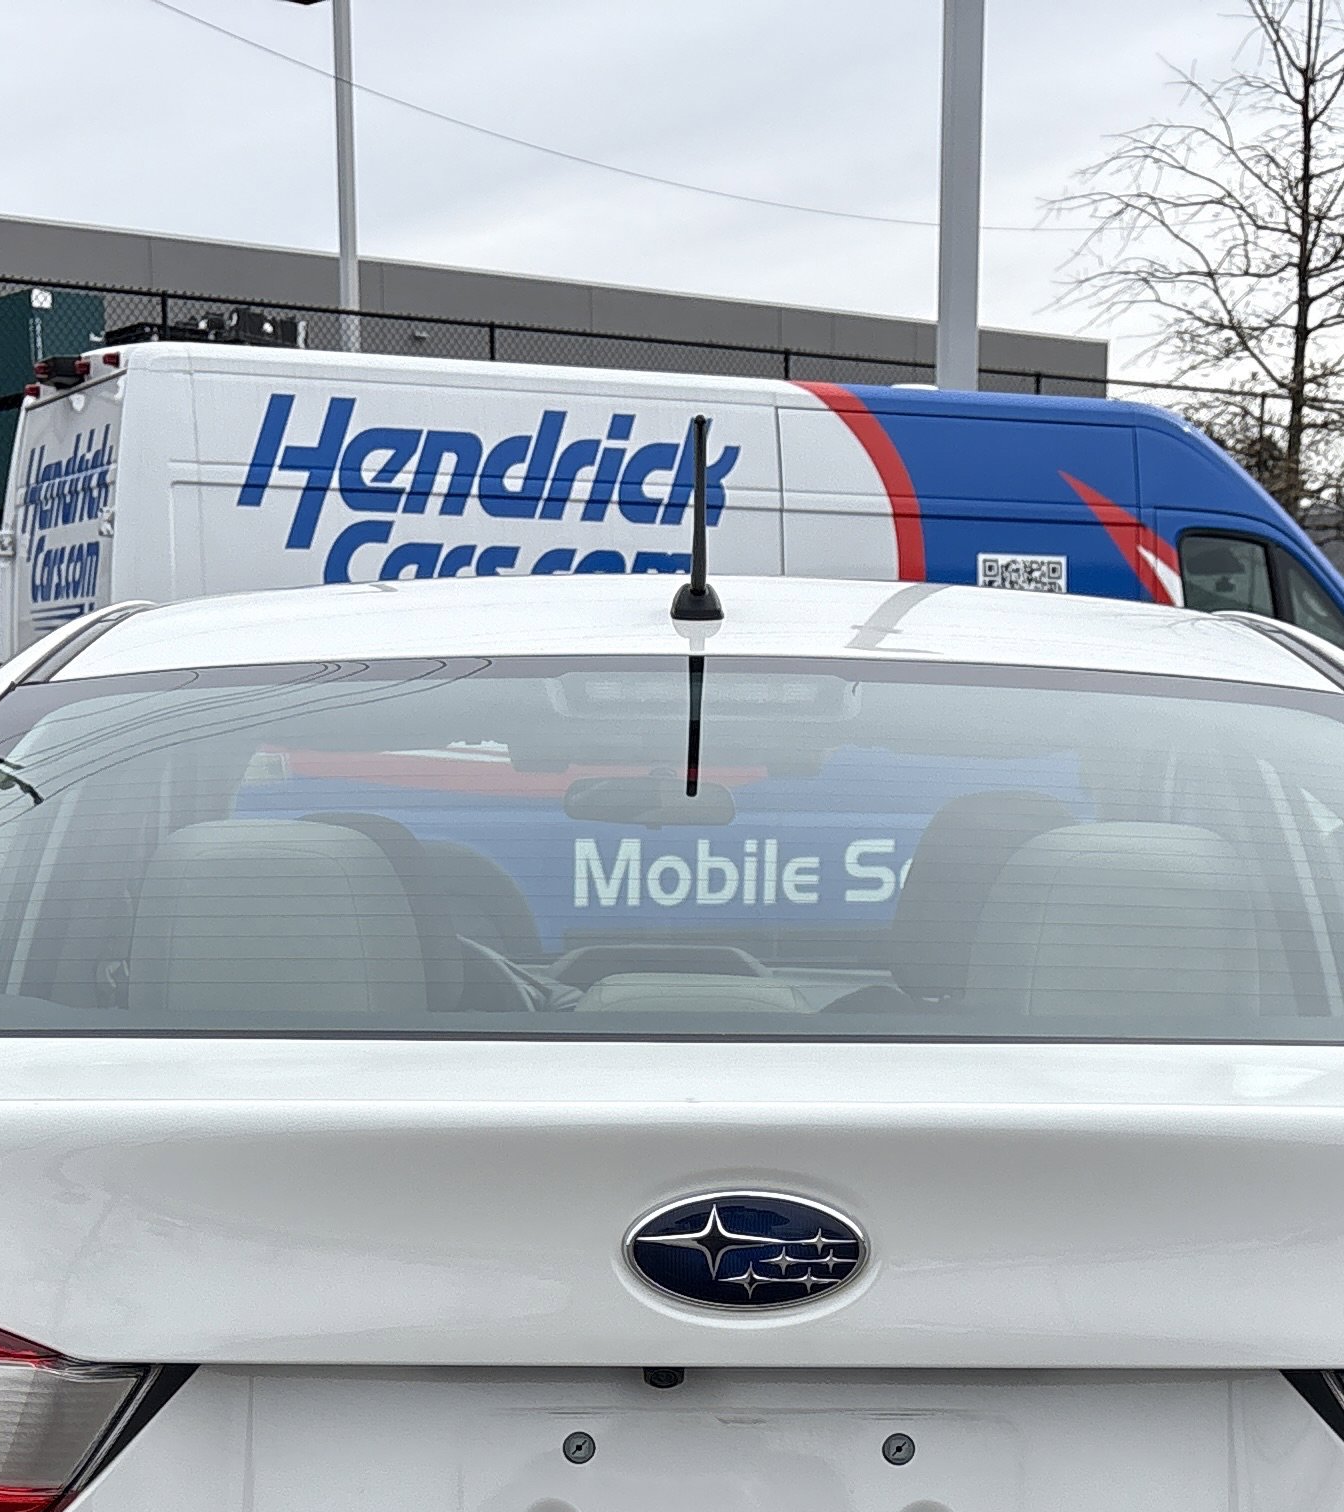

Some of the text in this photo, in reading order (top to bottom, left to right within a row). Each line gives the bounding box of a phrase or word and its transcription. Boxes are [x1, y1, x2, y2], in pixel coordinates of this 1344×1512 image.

[21, 423, 114, 563] Hendrick
[237, 393, 742, 550] Hendrick
[573, 838, 913, 907] Mobile S
